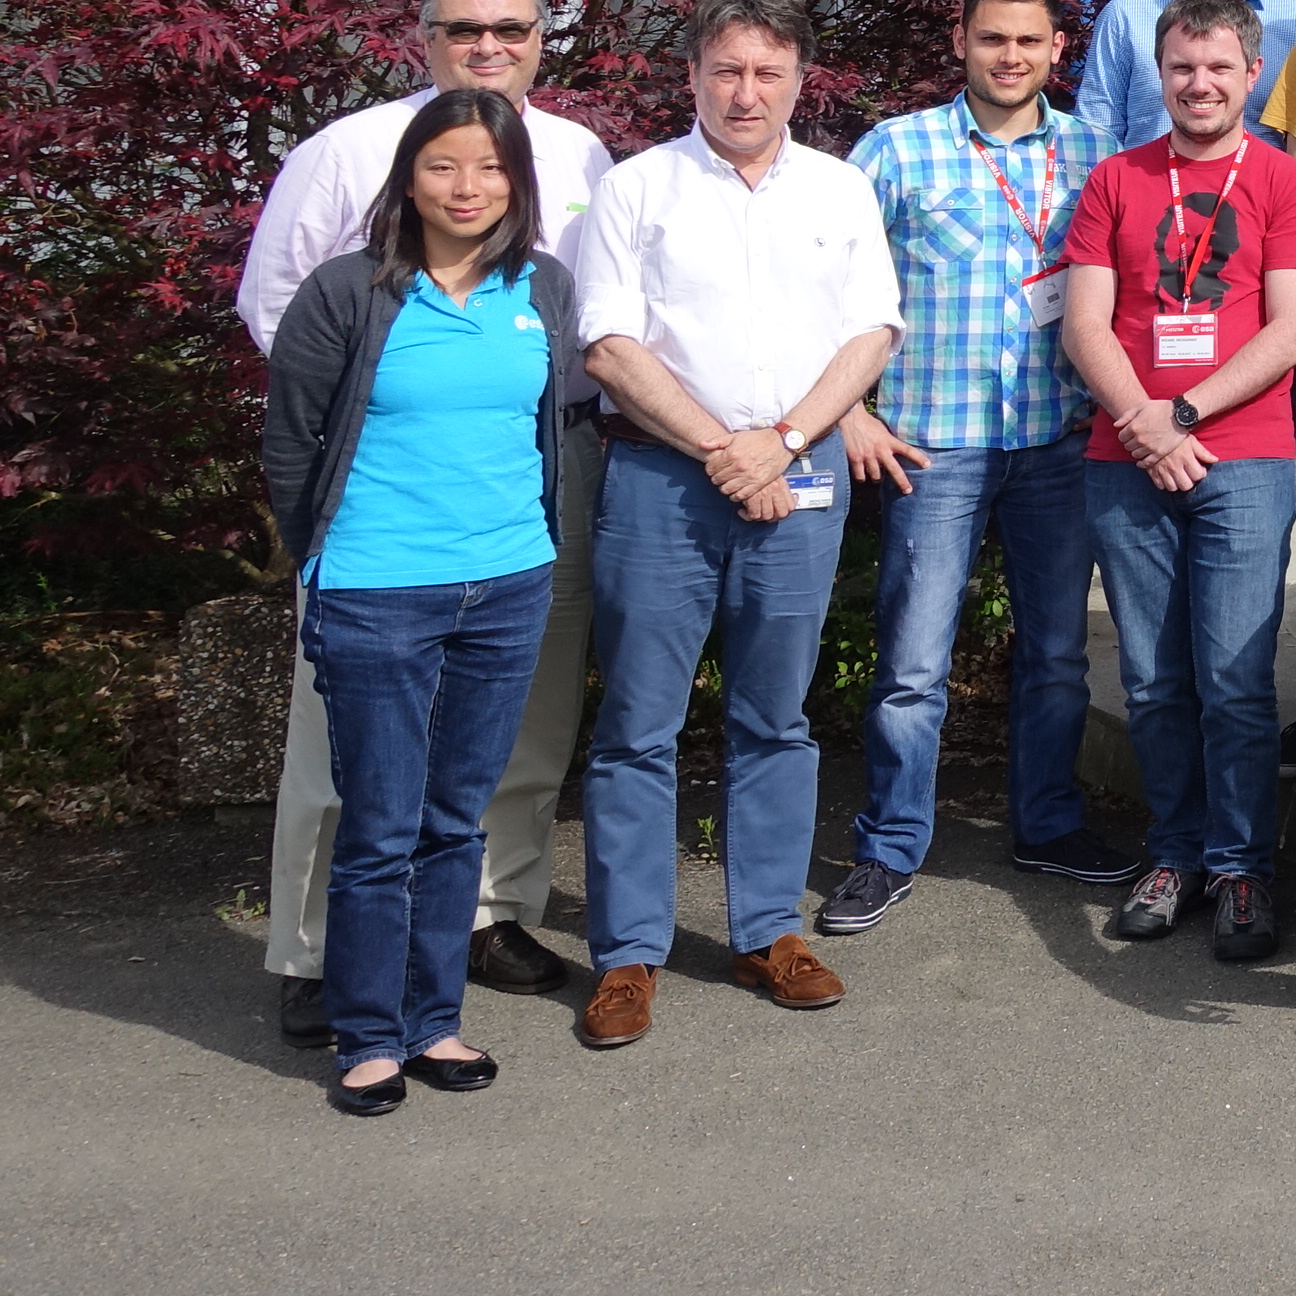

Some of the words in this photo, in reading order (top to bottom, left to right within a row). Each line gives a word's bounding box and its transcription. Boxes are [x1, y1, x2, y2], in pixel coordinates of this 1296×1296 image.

[980, 149, 1001, 178] VISITOR
[1234, 140, 1248, 163] VISITEUR
[1043, 180, 1053, 209] VISITOR
[1170, 168, 1180, 197] VISITEUR
[1222, 170, 1238, 197] VISITEUR
[1015, 208, 1036, 238] VISITOR
[1175, 204, 1185, 235] VISITEUR
